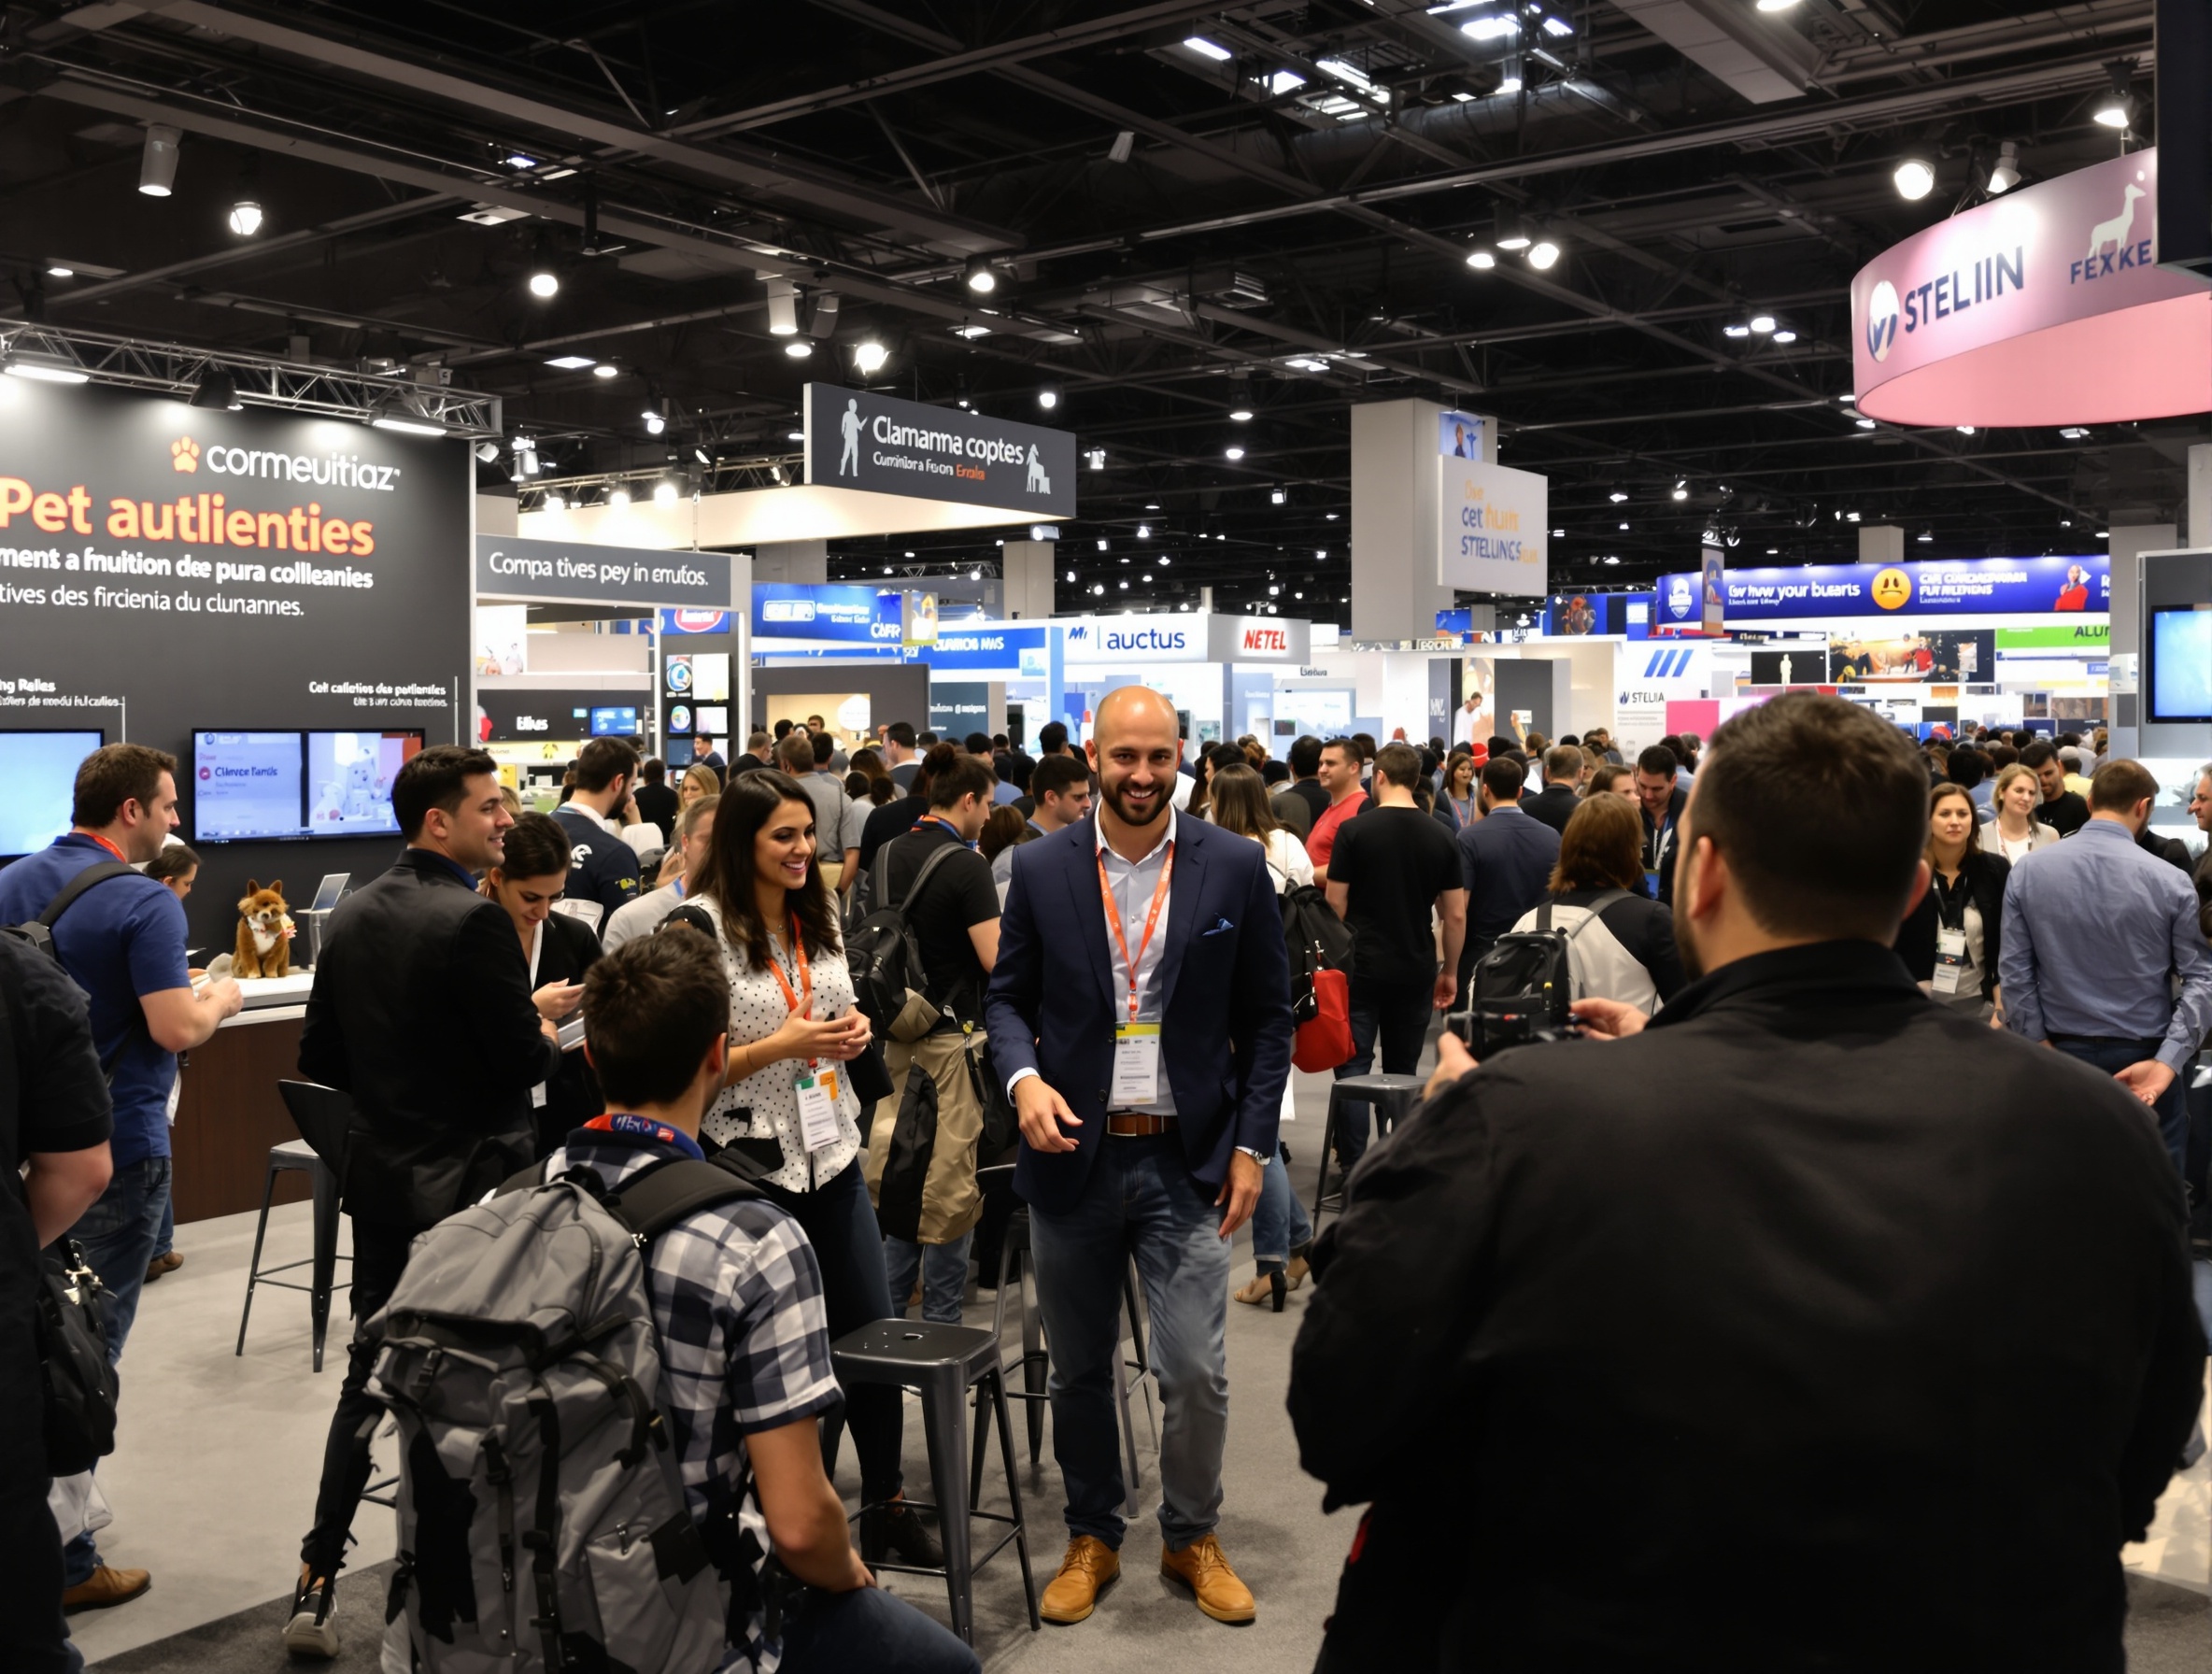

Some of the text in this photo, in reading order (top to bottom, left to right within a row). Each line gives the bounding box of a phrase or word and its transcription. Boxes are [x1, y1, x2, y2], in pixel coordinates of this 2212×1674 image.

[2070, 239, 2153, 284] FEXKE
[966, 437, 1024, 465] coptes
[0, 477, 375, 557] Pet autlienties
[64, 553, 80, 571] a
[216, 561, 266, 585] pura
[489, 551, 553, 580] Compa
[557, 557, 597, 579] tives
[601, 563, 631, 585] pey
[633, 562, 648, 582] in
[51, 585, 90, 606] des
[175, 590, 201, 612] du
[1777, 585, 1809, 601] your
[1107, 629, 1185, 650] auctus
[1243, 629, 1286, 651] NETEL
